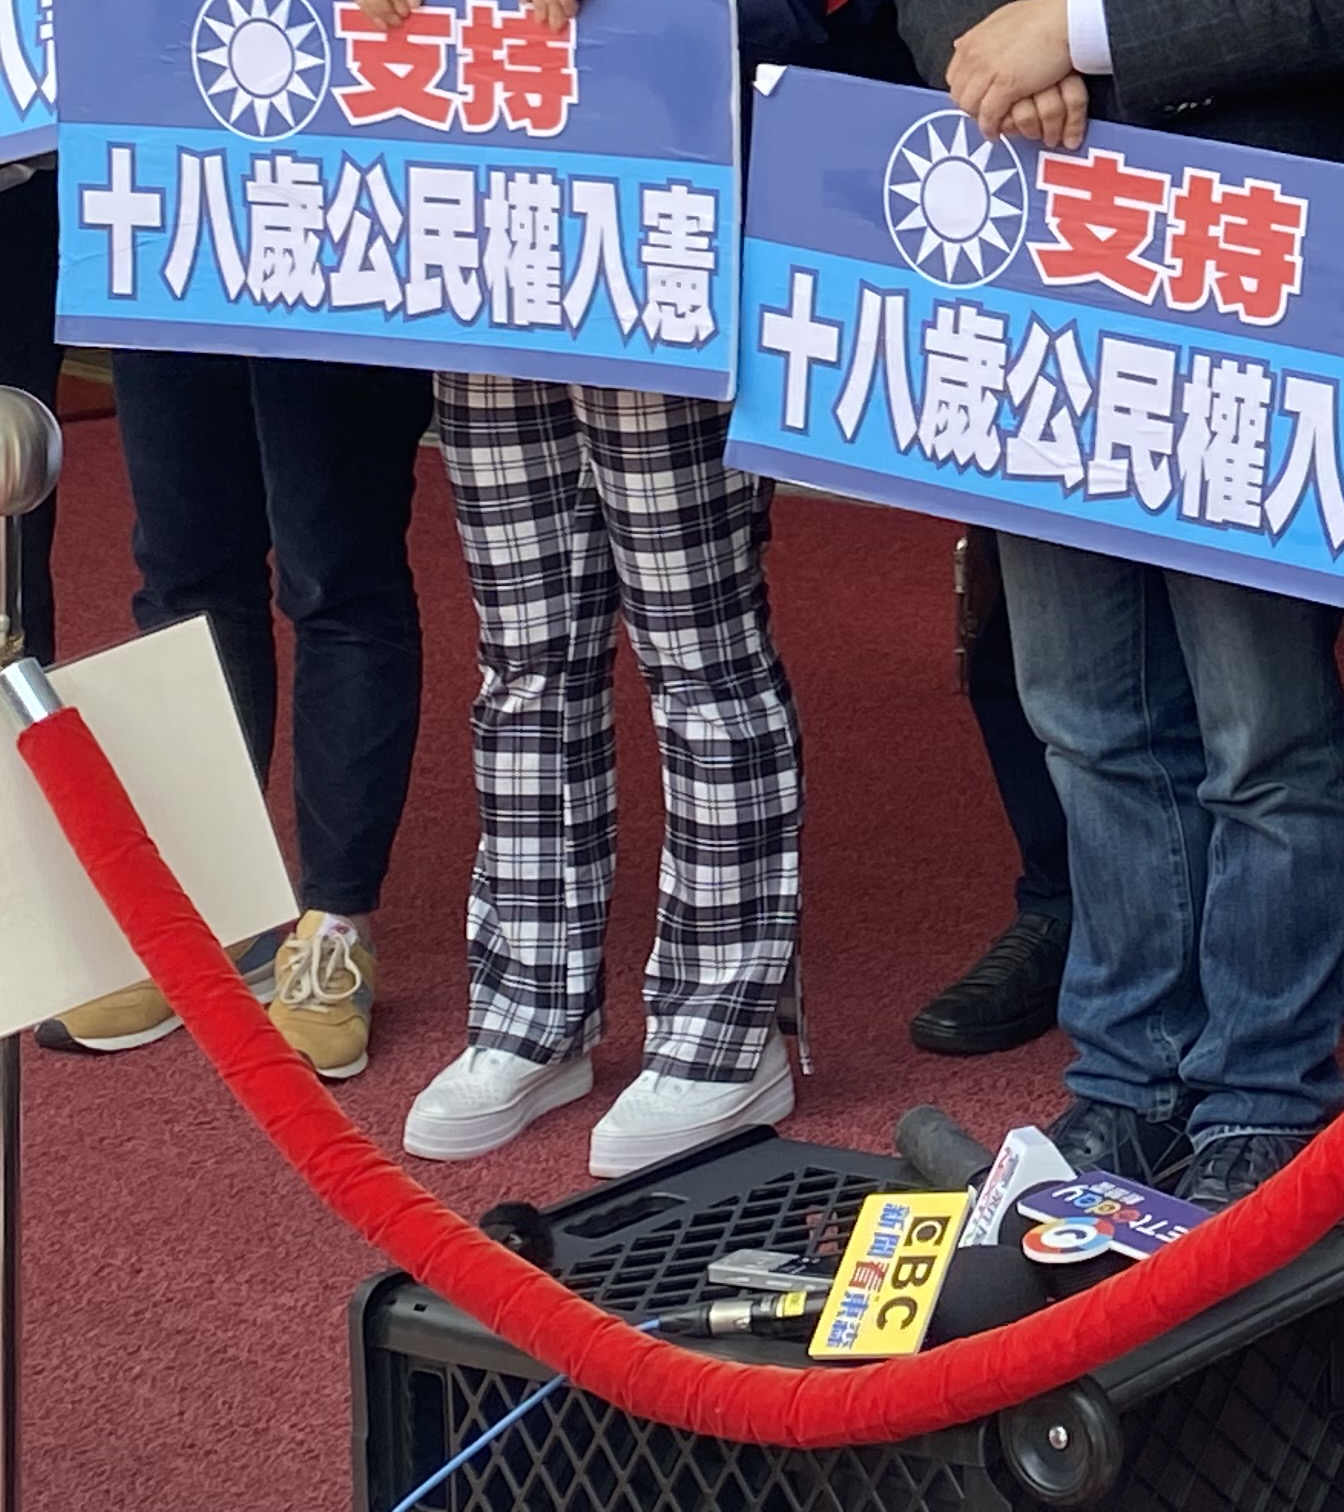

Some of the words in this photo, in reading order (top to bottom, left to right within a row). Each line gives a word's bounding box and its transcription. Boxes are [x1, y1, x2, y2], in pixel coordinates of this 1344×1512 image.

[79, 144, 718, 351] 十八歲公民權入憲
[1026, 145, 1310, 328] 支持
